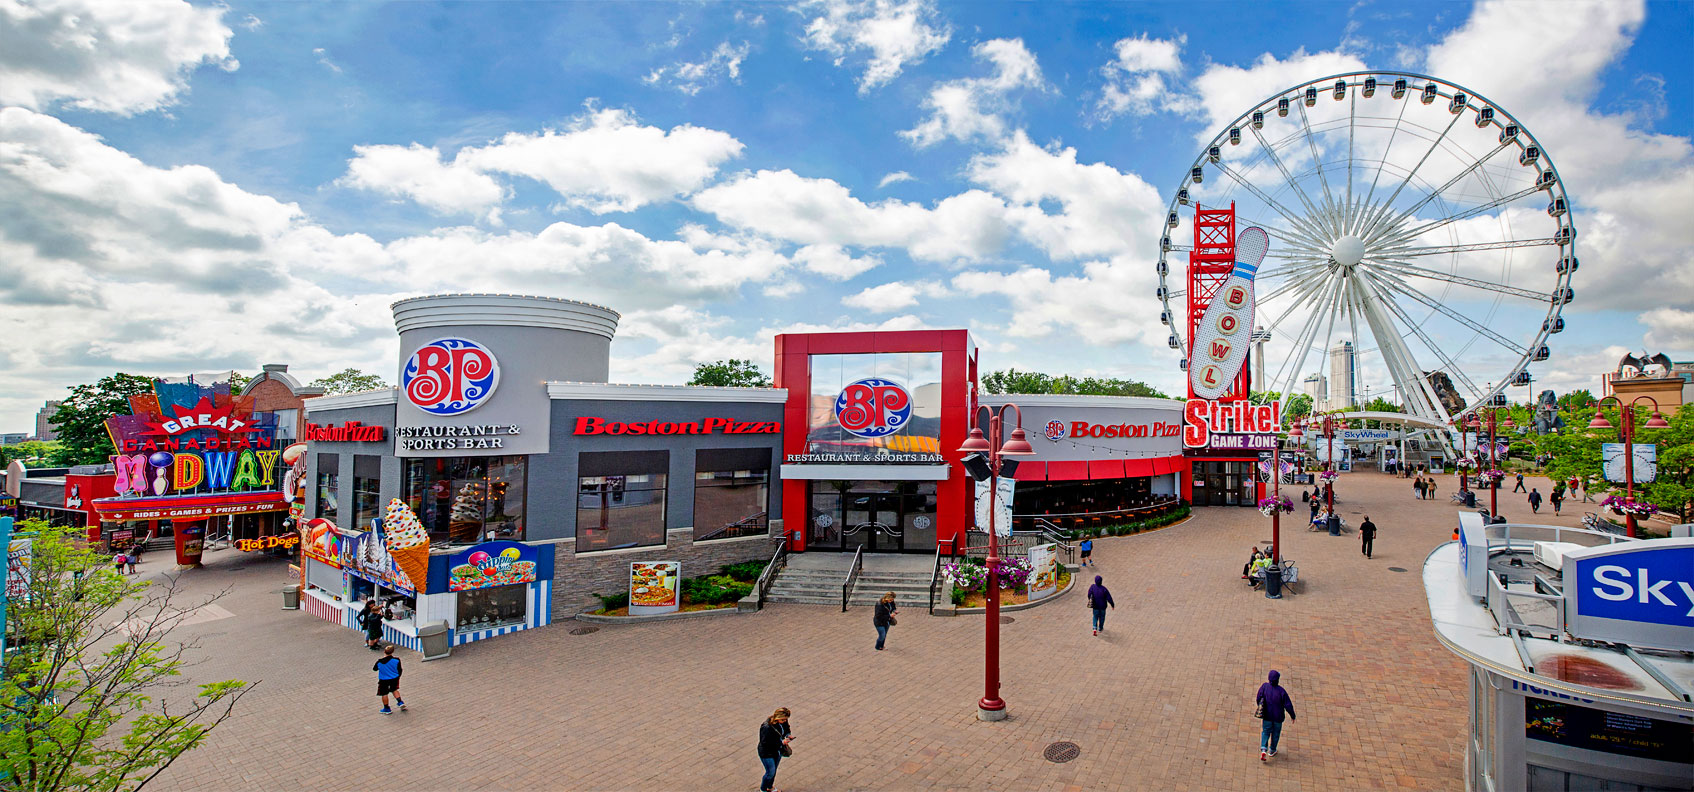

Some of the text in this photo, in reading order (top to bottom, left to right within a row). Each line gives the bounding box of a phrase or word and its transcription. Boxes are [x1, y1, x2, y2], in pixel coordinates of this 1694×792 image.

[1204, 288, 1244, 384] BOWL
[407, 345, 492, 406] BP
[839, 384, 908, 430] BP
[162, 414, 246, 434] GREAT
[395, 424, 520, 438] RESTAURANT &
[572, 417, 781, 435] Boston Pizza
[1069, 421, 1181, 438] Boston Pizza
[1183, 399, 1281, 448] Strike!
[123, 436, 271, 450] CANADIAN
[1211, 434, 1277, 448] GAME ZONE
[1344, 431, 1389, 439] SkyWheel
[401, 437, 504, 450] SPORTS BAR
[787, 454, 943, 462] RESTAURANT & SPORTS BAR
[215, 505, 247, 513] PRIZES
[239, 536, 299, 552] Hot Dogs
